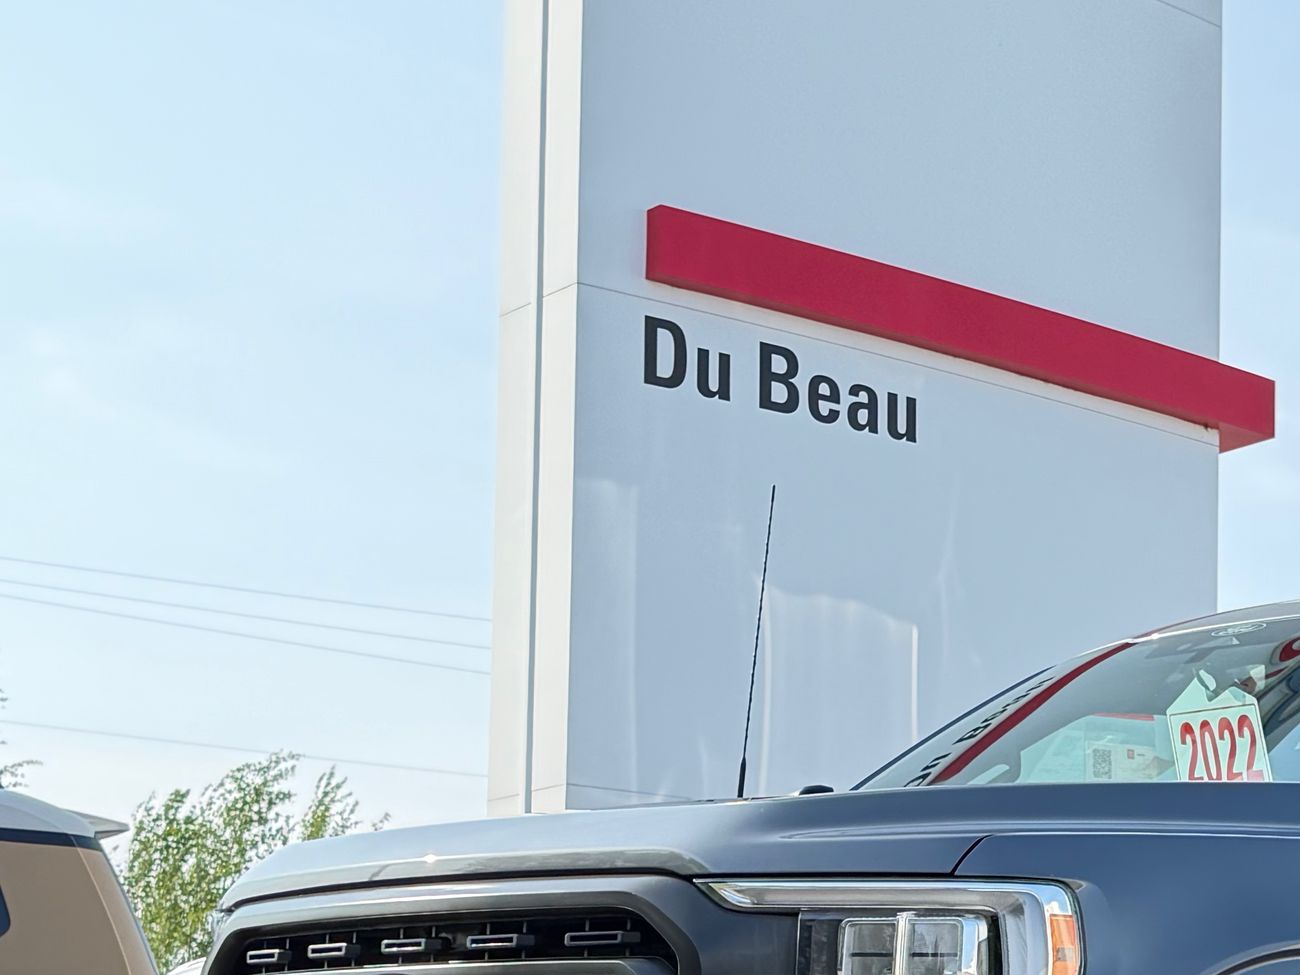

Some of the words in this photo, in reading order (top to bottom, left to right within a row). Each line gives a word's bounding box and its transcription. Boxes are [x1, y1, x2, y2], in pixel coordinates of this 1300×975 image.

[643, 314, 732, 402] Du
[758, 341, 918, 443] Beau
[1179, 713, 1265, 782] 2022
